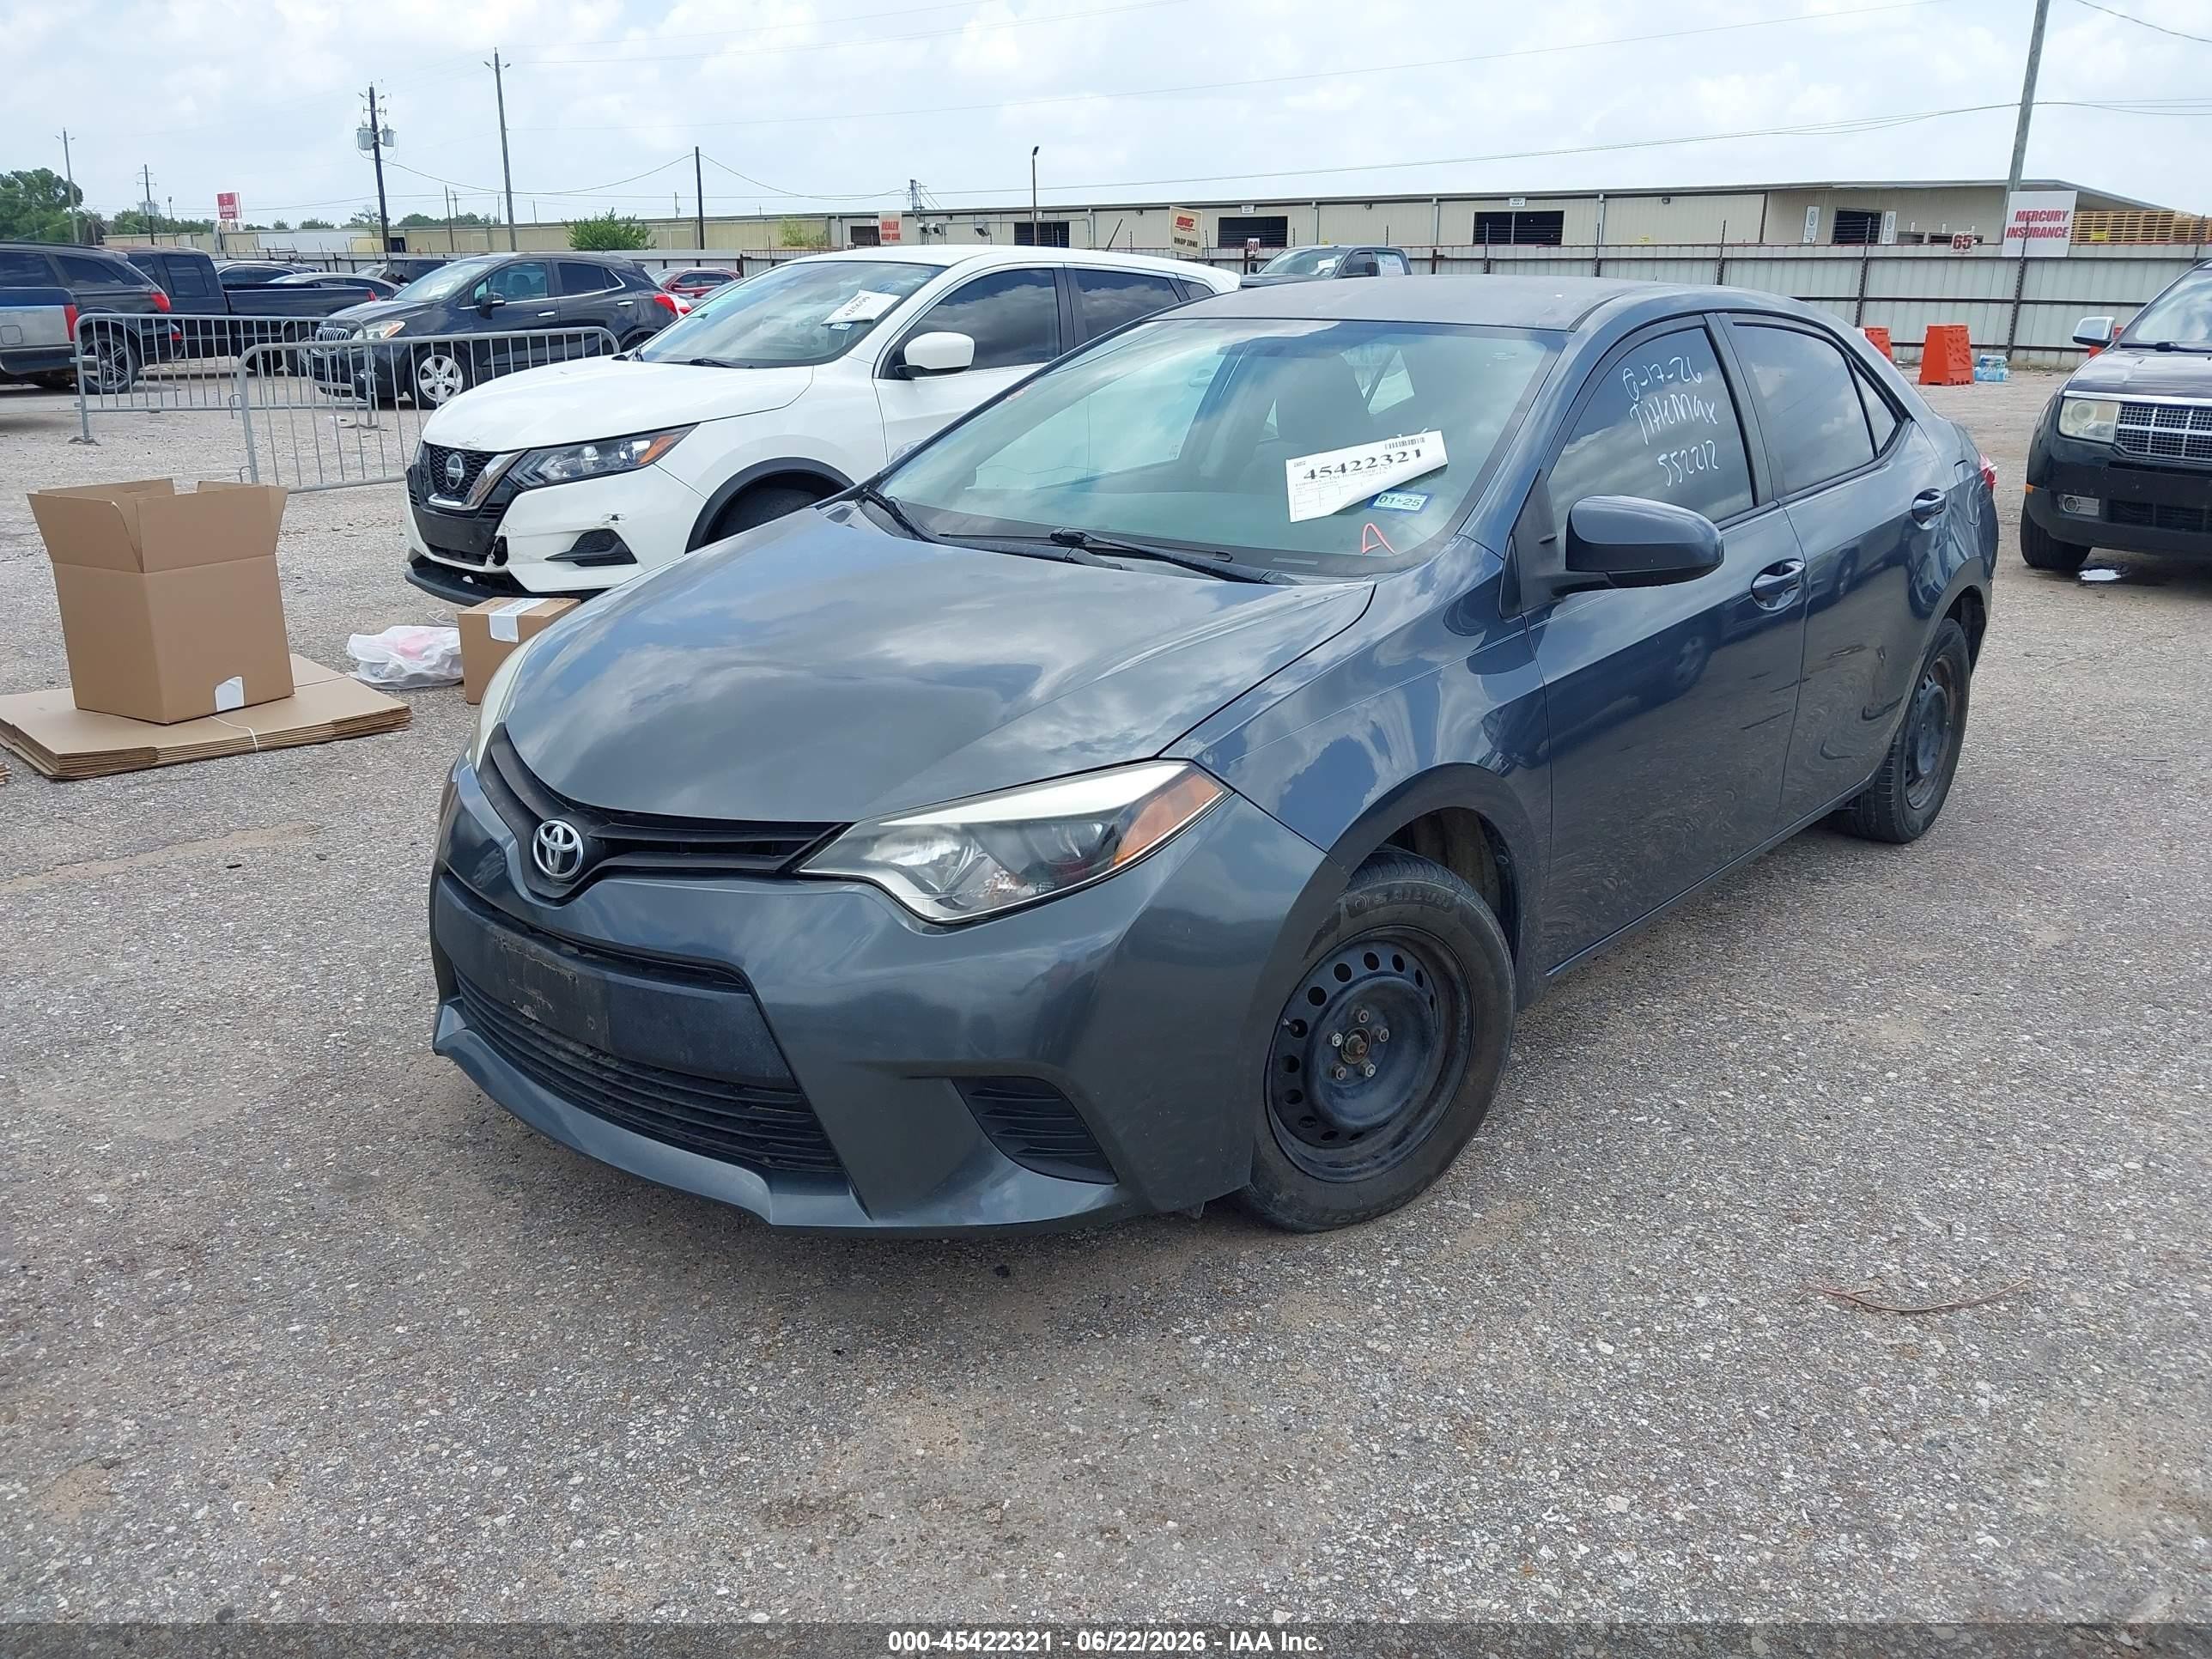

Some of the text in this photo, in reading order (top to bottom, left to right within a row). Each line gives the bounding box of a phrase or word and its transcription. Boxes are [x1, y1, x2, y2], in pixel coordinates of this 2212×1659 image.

[2014, 210, 2069, 222] MERCURY
[1953, 234, 1973, 250] 65
[2006, 227, 2069, 238] INSURANCE
[1304, 448, 1422, 480] 45422321
[1657, 440, 1719, 487] 552212
[1362, 522, 1395, 555] A
